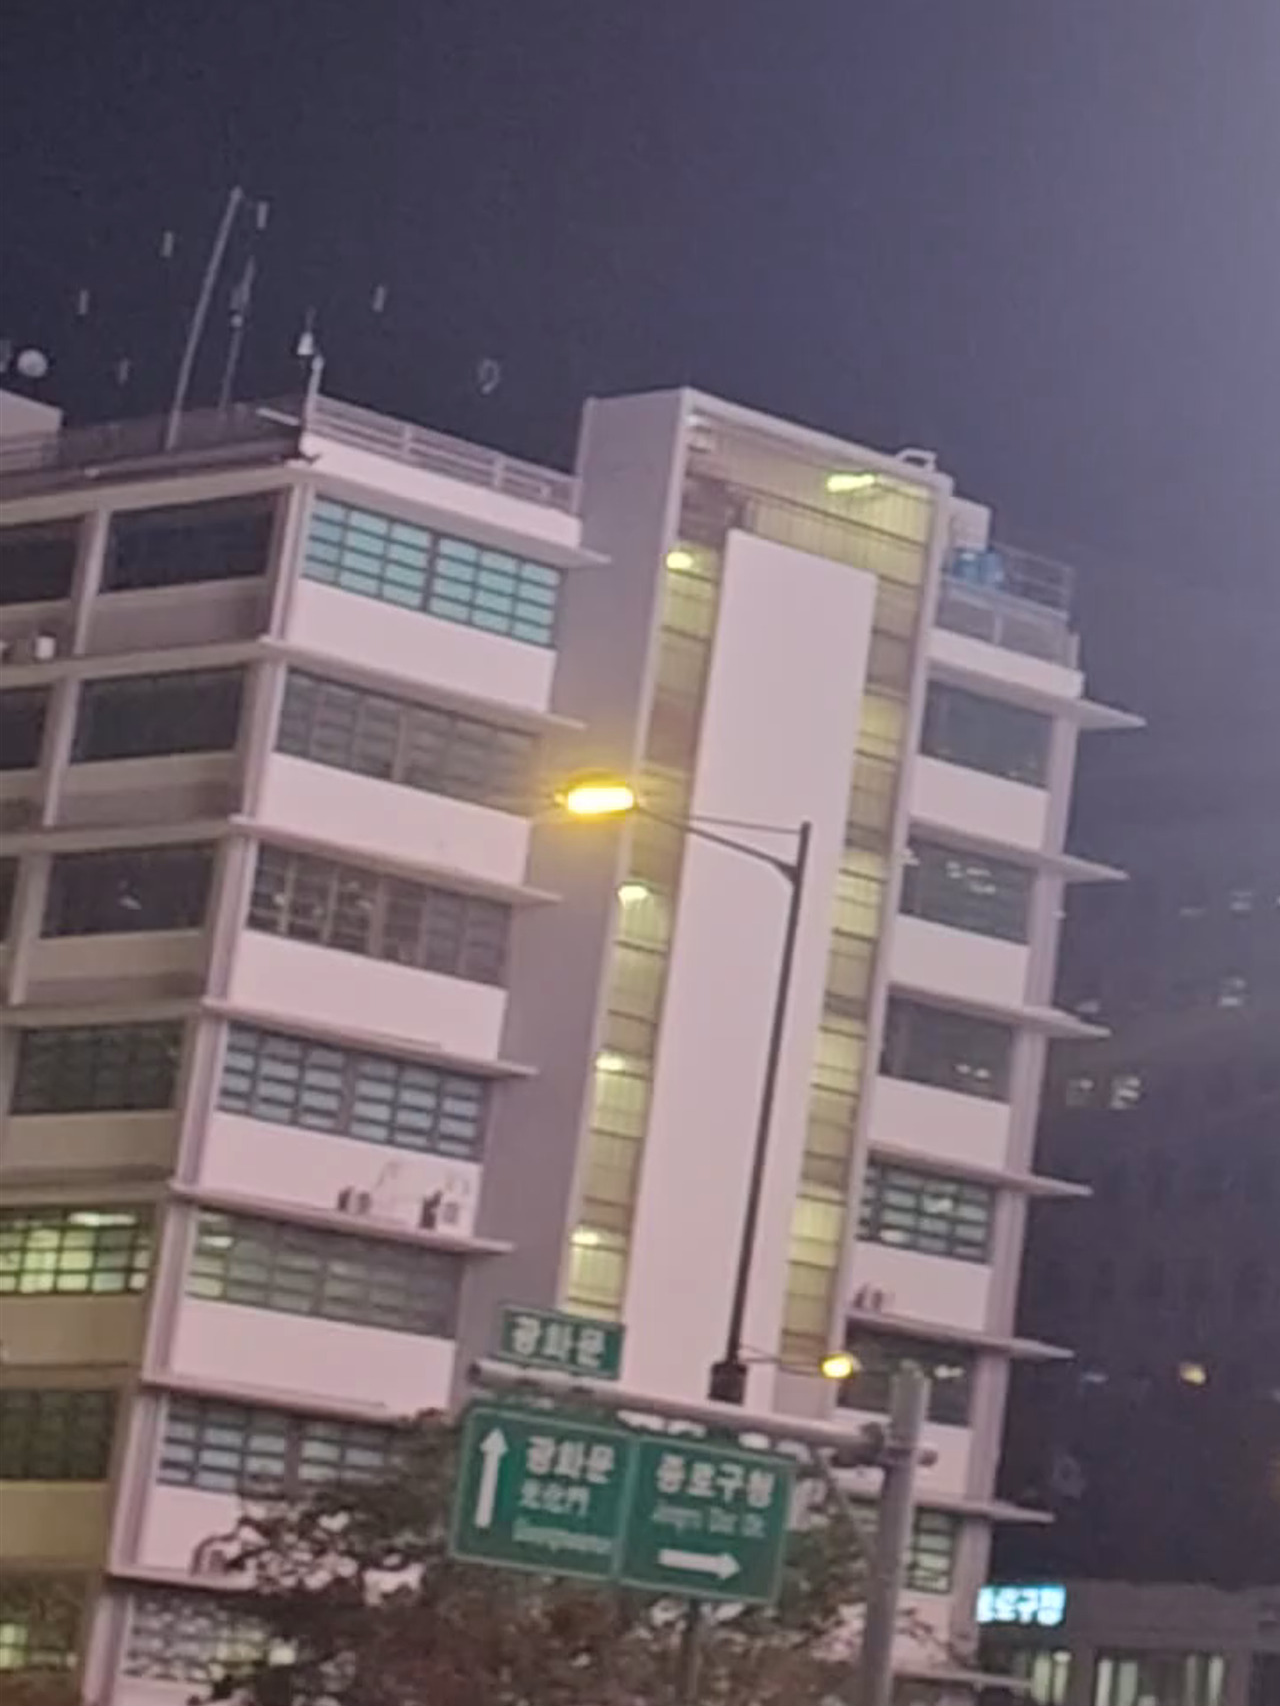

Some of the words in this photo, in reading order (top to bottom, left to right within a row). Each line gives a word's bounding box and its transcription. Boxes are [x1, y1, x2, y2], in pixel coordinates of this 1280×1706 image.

[511, 1316, 606, 1369] 광화문
[526, 1435, 615, 1485] 광화문
[656, 1452, 775, 1509] 종로구청
